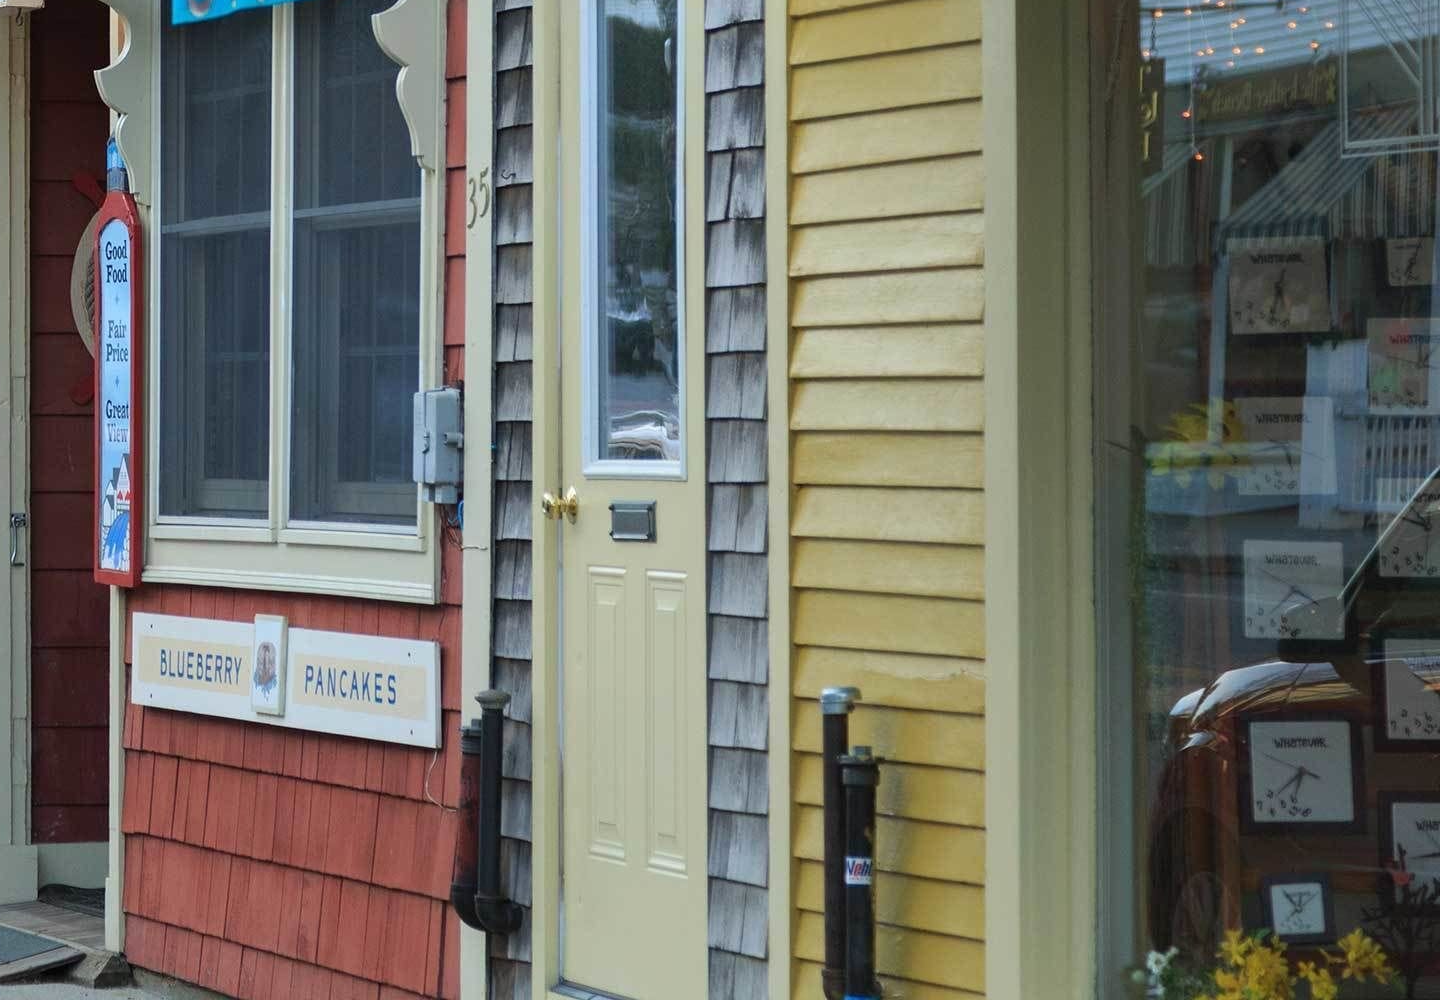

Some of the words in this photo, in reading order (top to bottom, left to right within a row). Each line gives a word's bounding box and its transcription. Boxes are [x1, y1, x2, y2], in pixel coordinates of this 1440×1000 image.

[466, 166, 490, 230] 35
[105, 240, 128, 261] Good
[106, 263, 128, 284] Food
[108, 319, 127, 339] Fair
[105, 342, 129, 363] Price
[105, 399, 129, 420] Great
[106, 421, 129, 444] View
[159, 648, 243, 686] BLUEBERRY
[304, 664, 398, 705] PANCAKES
